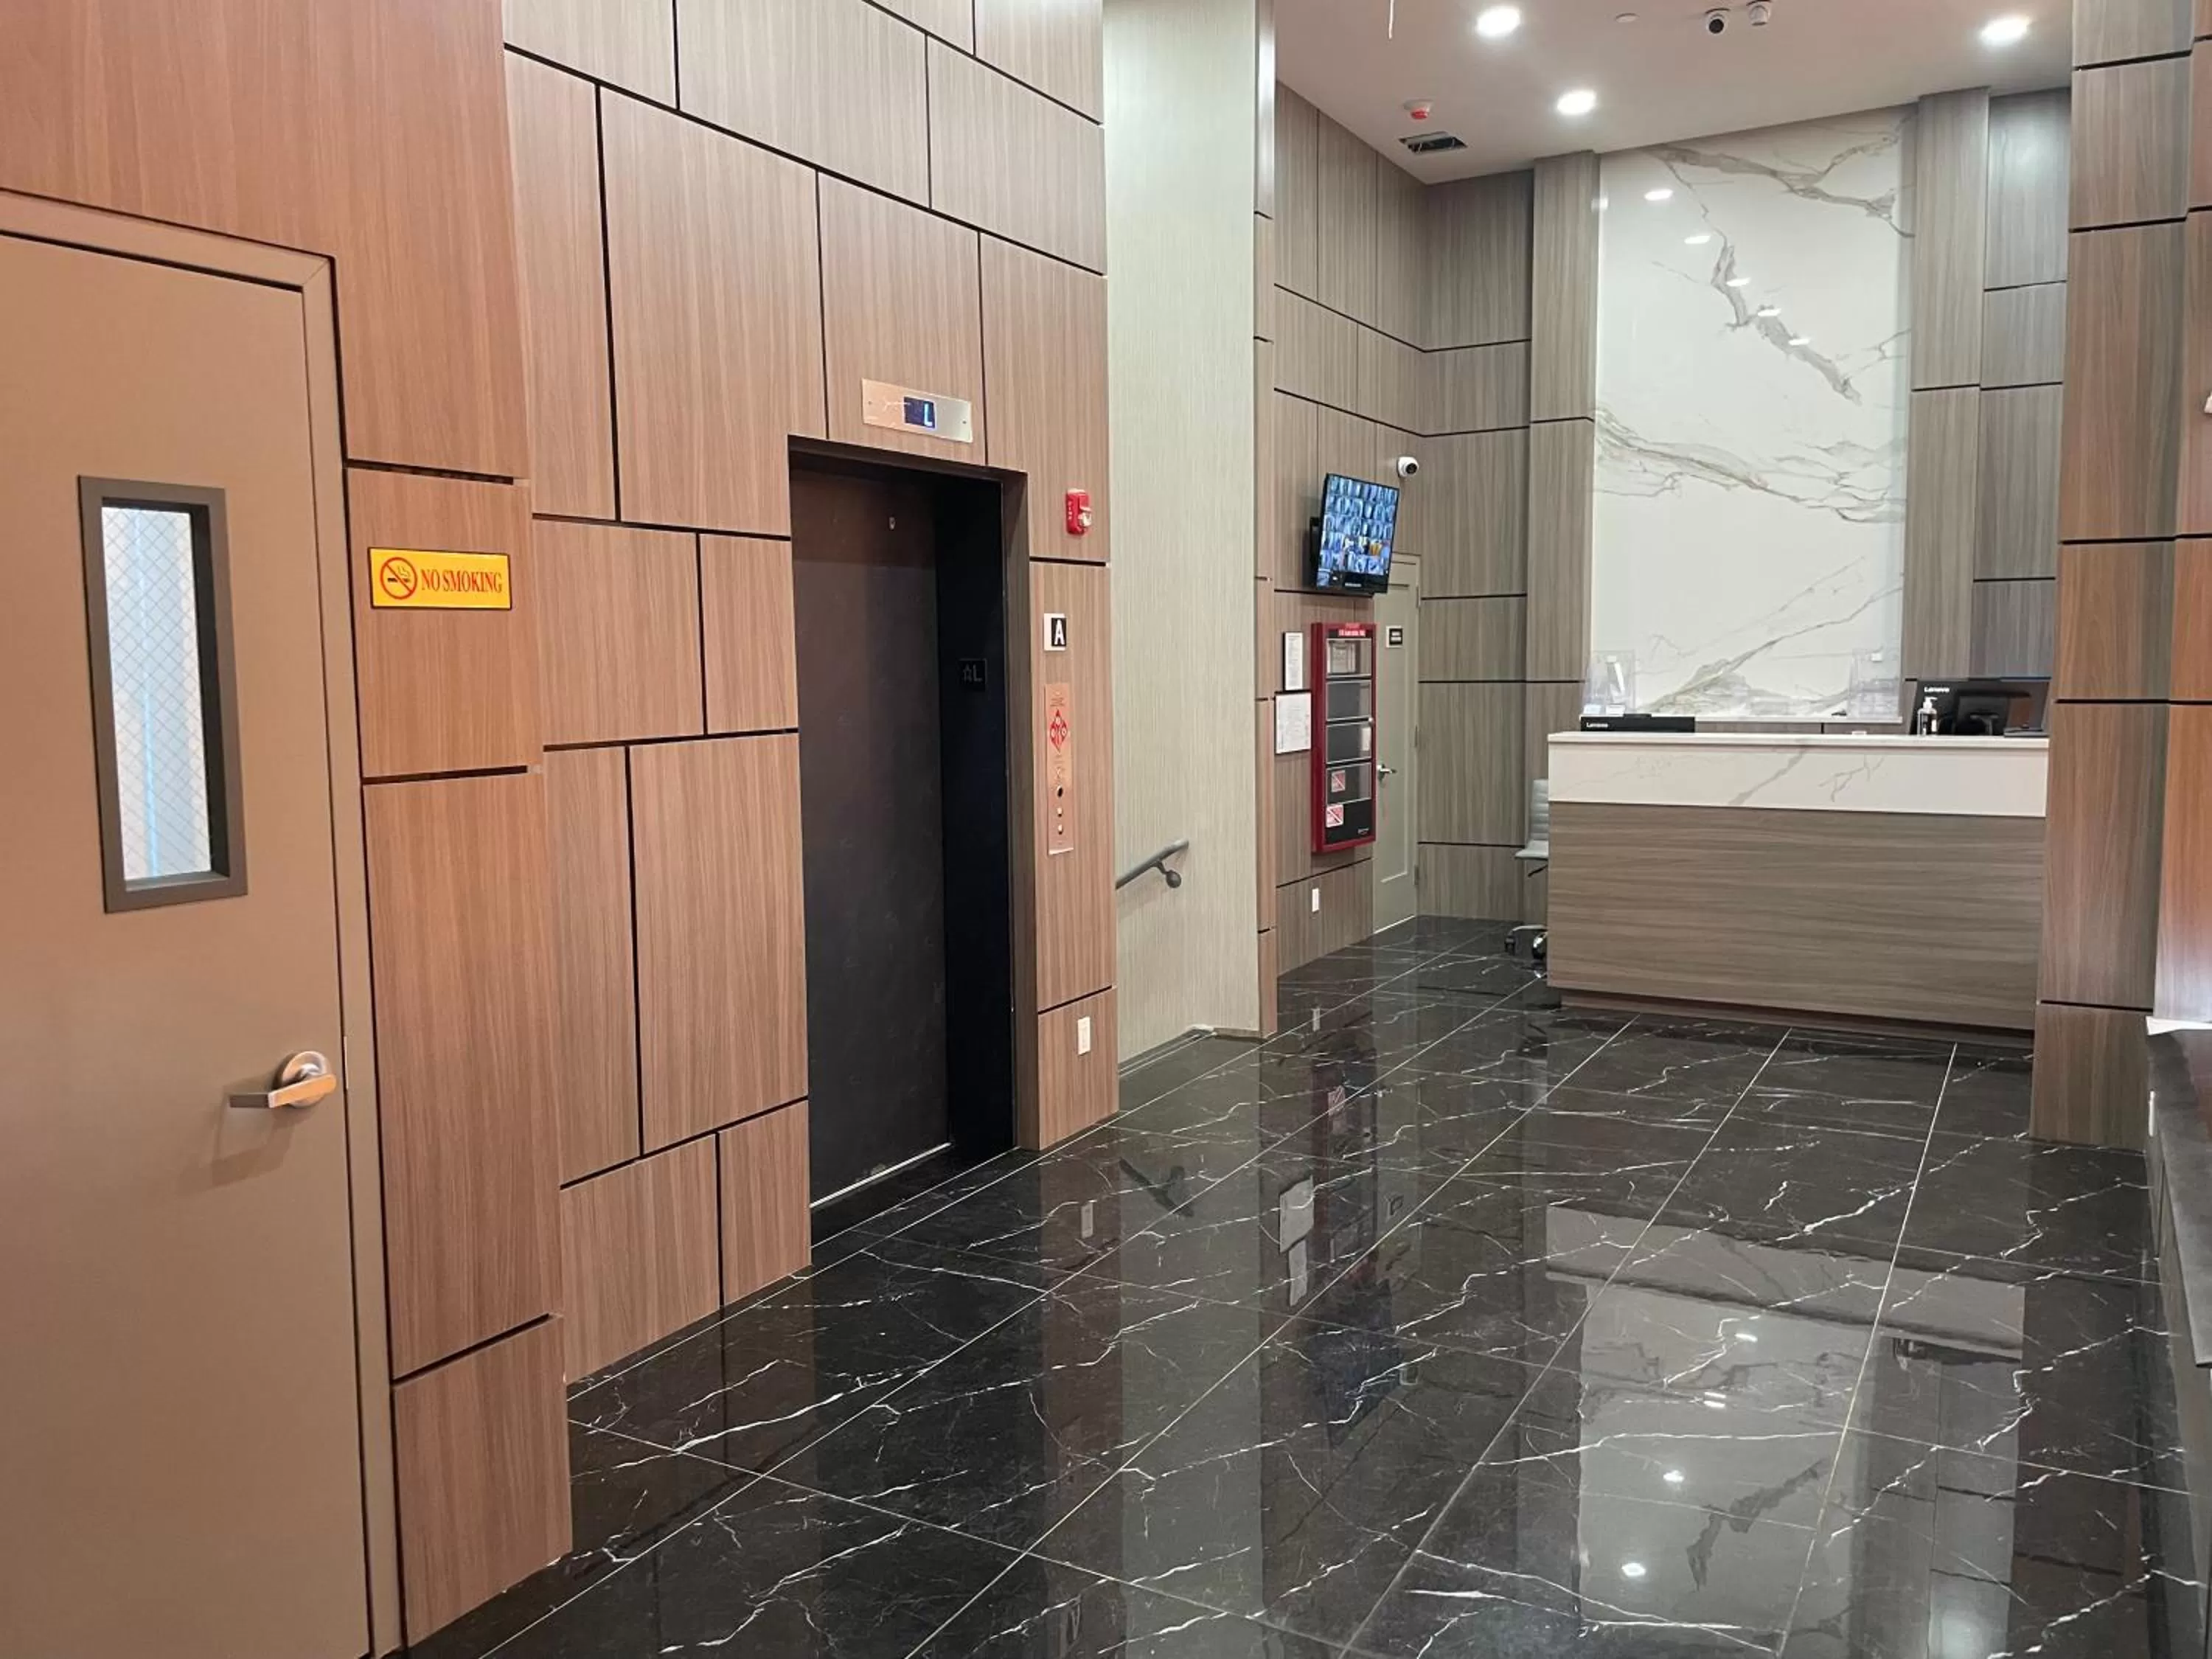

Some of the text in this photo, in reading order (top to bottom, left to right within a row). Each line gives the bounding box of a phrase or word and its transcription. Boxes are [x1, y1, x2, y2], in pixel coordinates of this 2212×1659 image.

[924, 403, 933, 427] L
[421, 568, 502, 593] NO SMOKING
[1054, 619, 1065, 645] A
